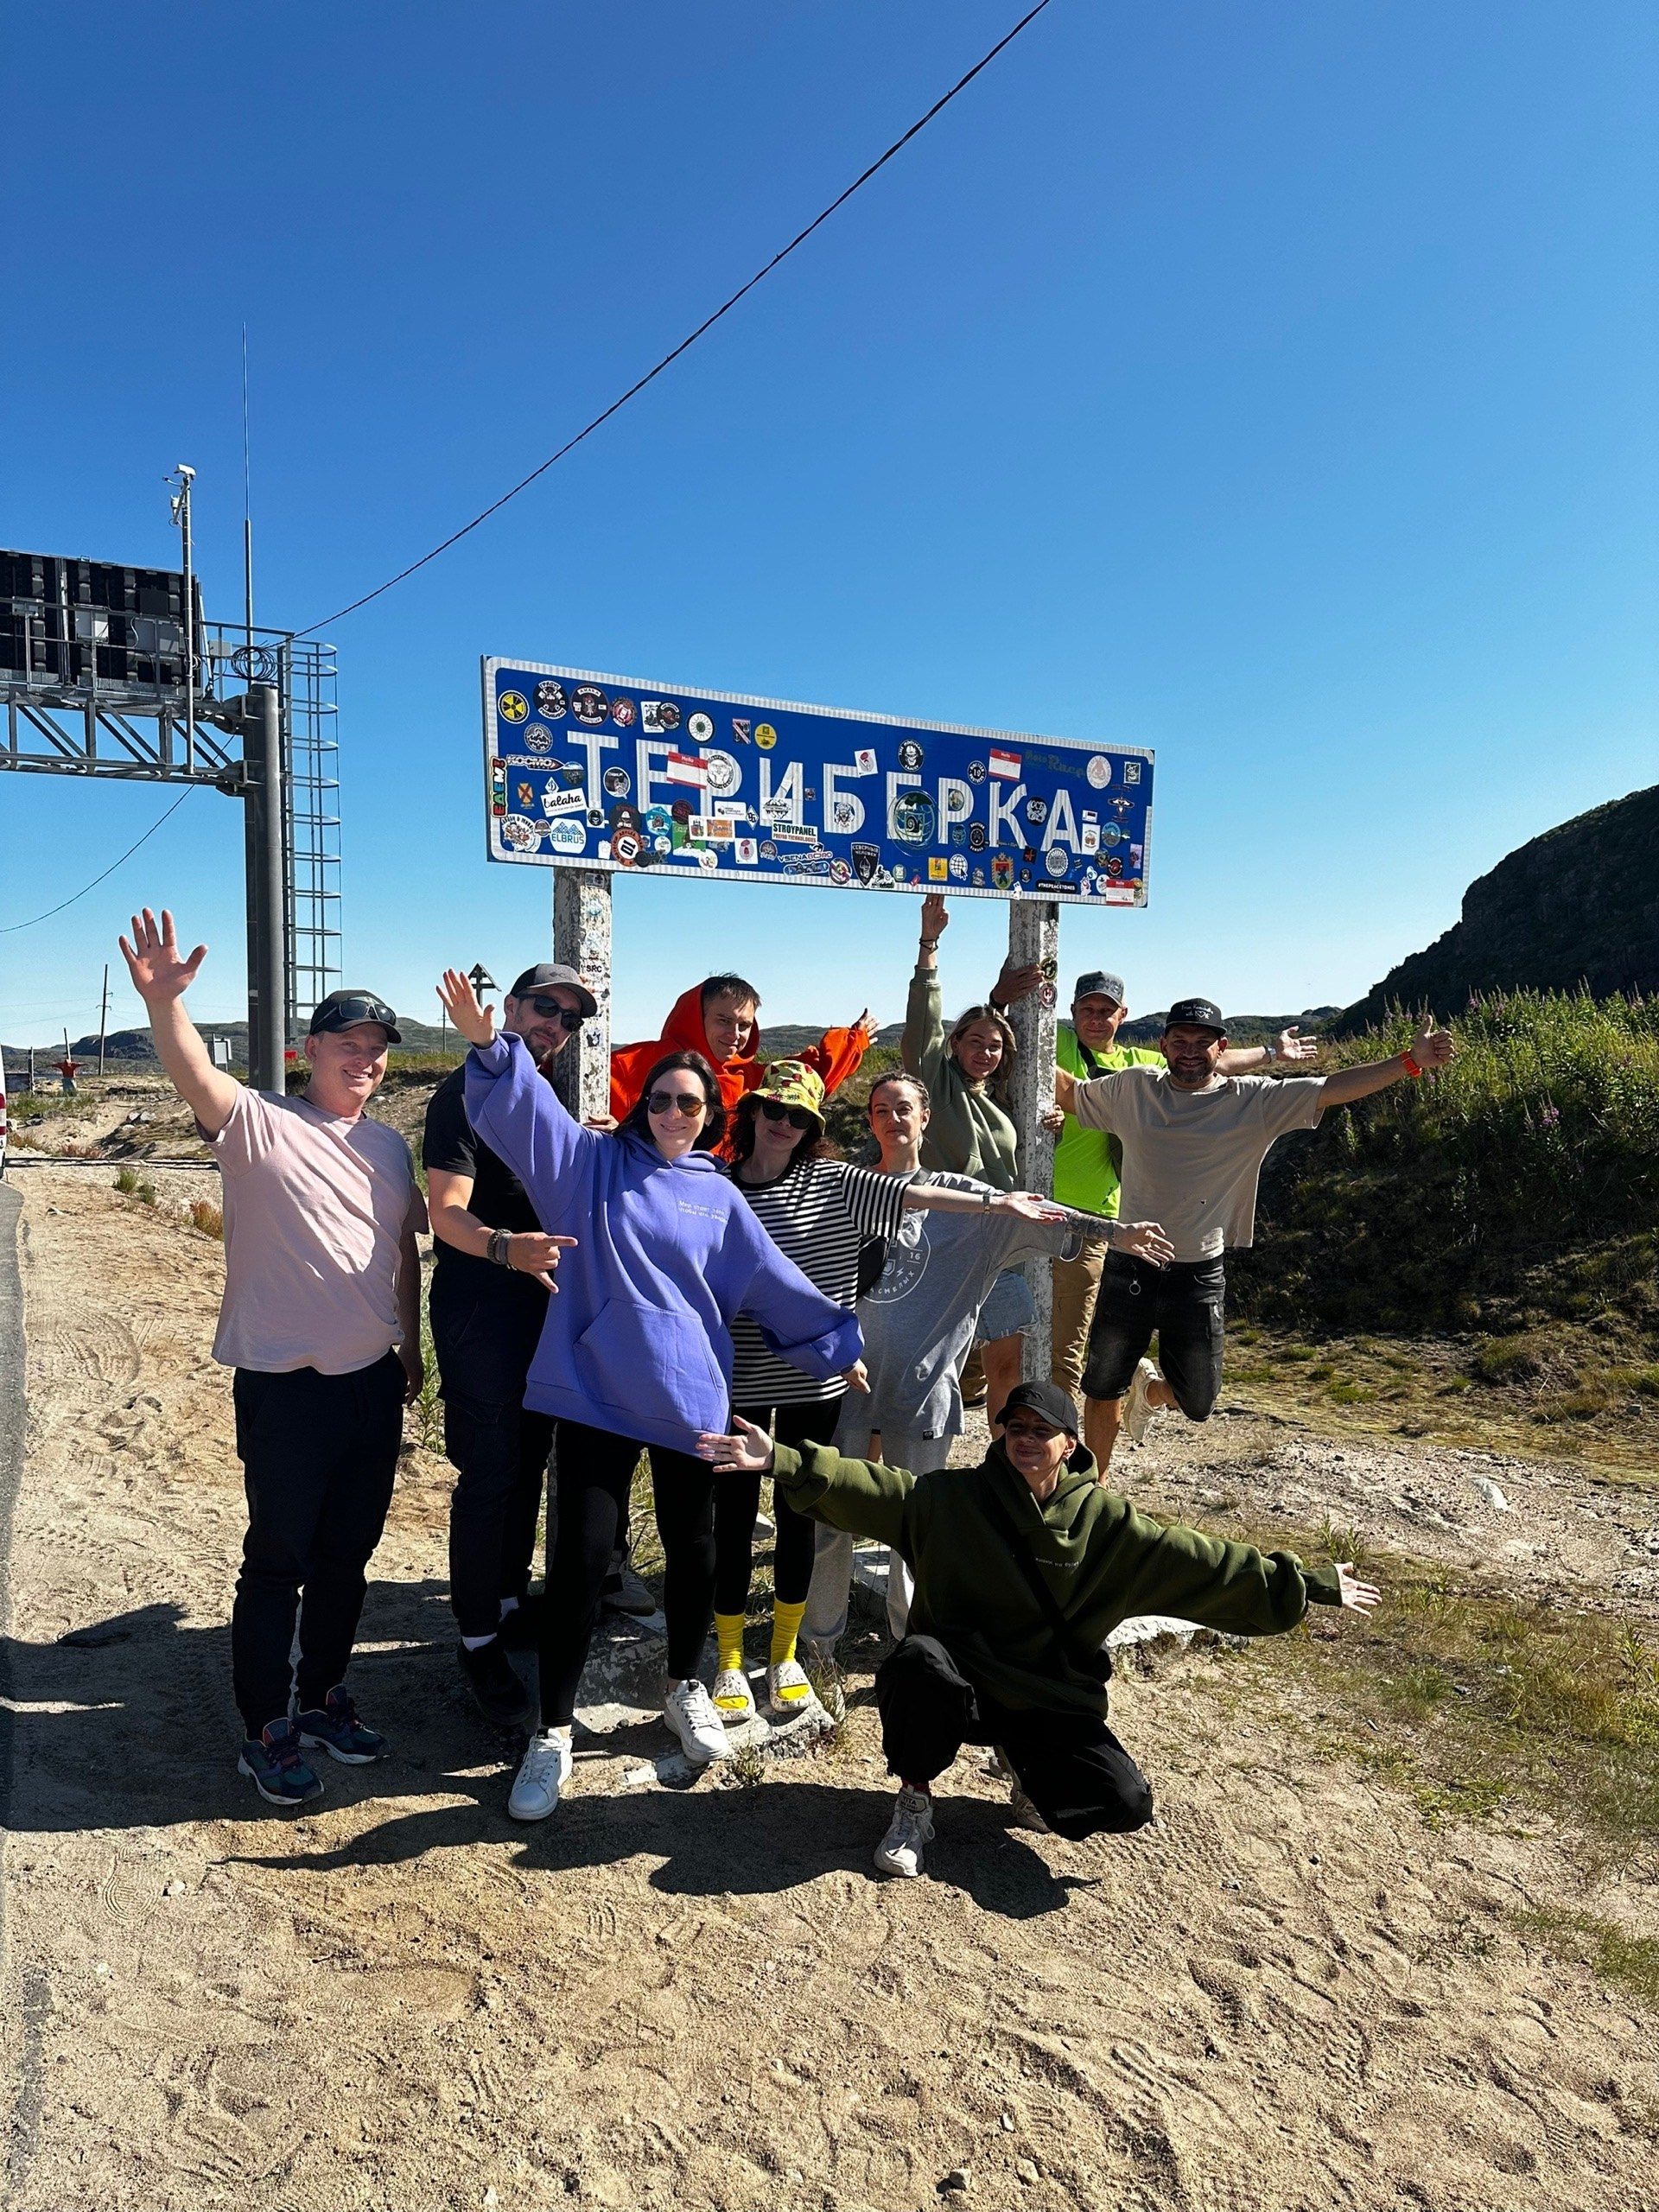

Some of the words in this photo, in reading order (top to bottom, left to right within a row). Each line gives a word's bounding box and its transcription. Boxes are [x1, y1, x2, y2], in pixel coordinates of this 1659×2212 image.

[567, 730, 1083, 855] ТЕРИБЕРКА
[773, 823, 817, 836] STROYPANEL
[552, 833, 585, 845] ELBRUS
[587, 964, 602, 974] SRC
[909, 1251, 920, 1261] 16
